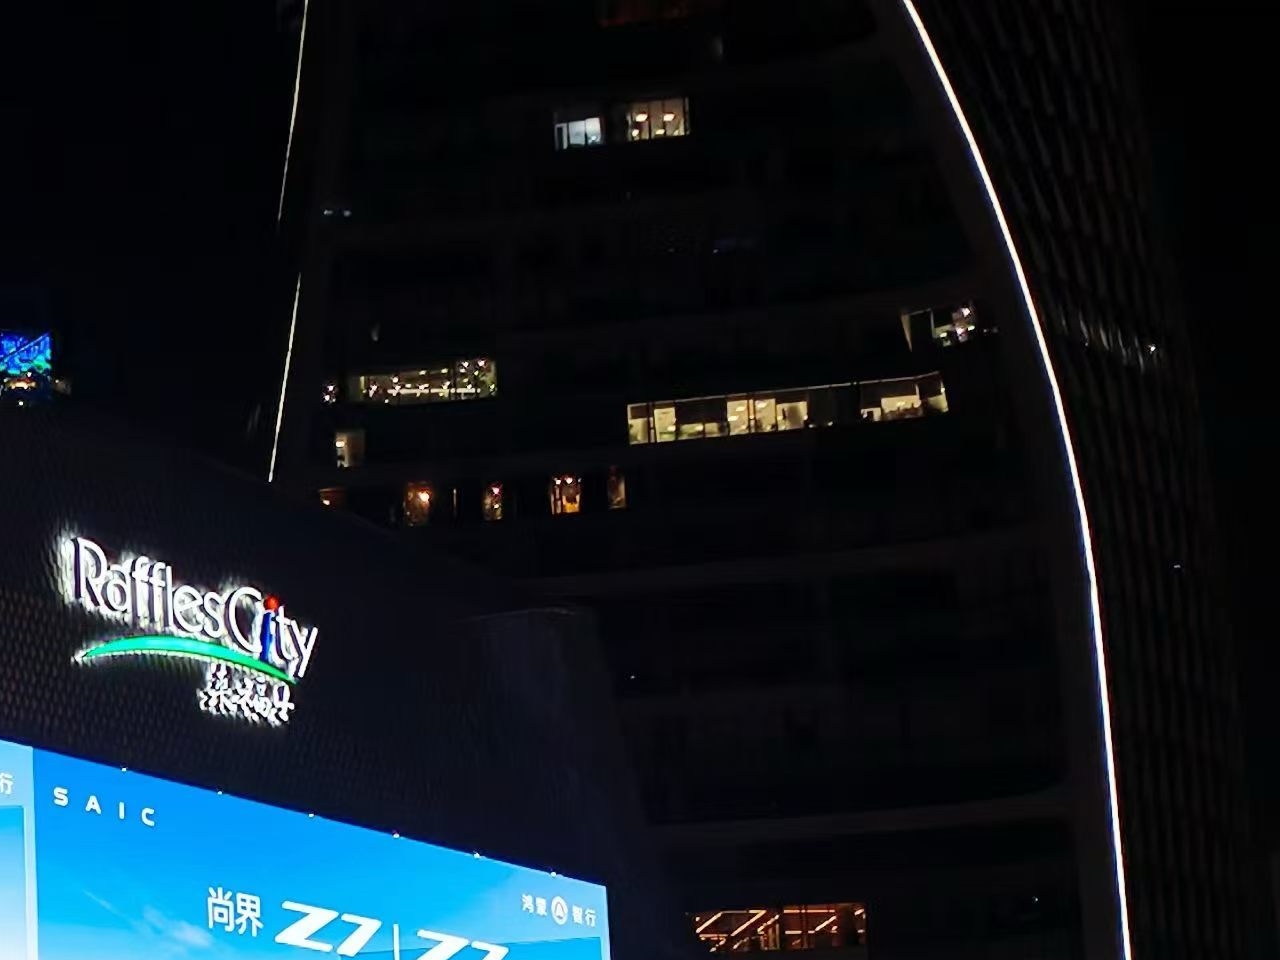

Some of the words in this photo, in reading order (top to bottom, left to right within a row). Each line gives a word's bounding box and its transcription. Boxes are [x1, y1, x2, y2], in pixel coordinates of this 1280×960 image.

[53, 786, 155, 827] SAIC
[207, 886, 263, 937] 尚界
[274, 900, 382, 957] Z7
